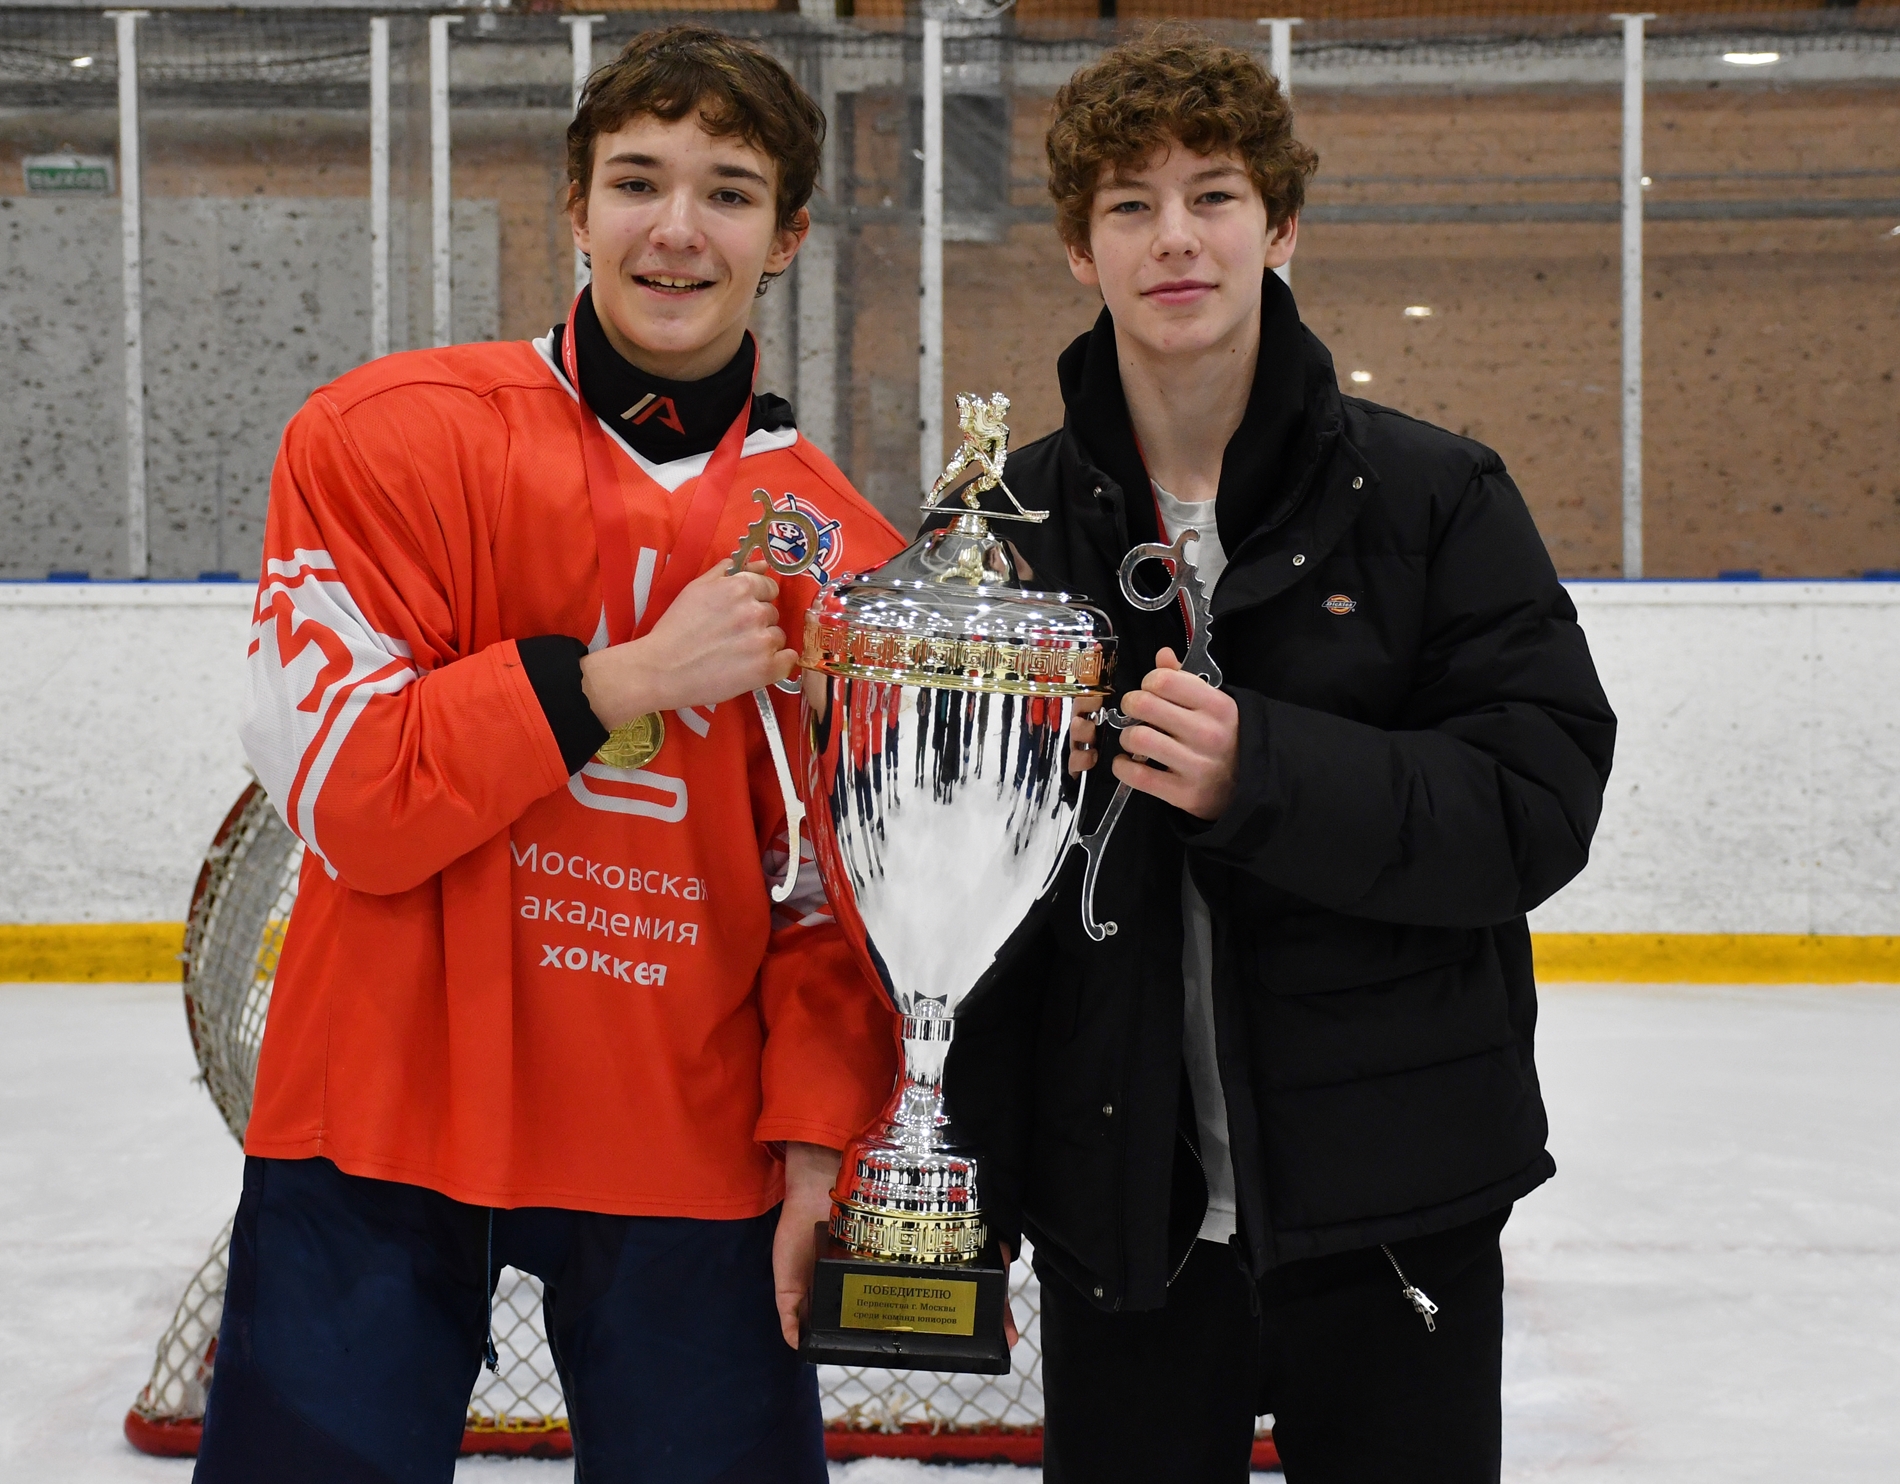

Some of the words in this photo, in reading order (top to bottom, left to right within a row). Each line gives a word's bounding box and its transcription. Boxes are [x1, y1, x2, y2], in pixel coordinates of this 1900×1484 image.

[510, 840, 709, 901] Московская
[520, 895, 699, 946] академия
[539, 944, 668, 987] хоккея
[856, 1298, 909, 1309] Первенства
[920, 1302, 956, 1313] Москвы
[863, 1284, 952, 1299] ПОБЕДИТЕЛЮ
[853, 1311, 880, 1320] среди
[882, 1313, 915, 1322] команд
[917, 1315, 957, 1325] юниоров
